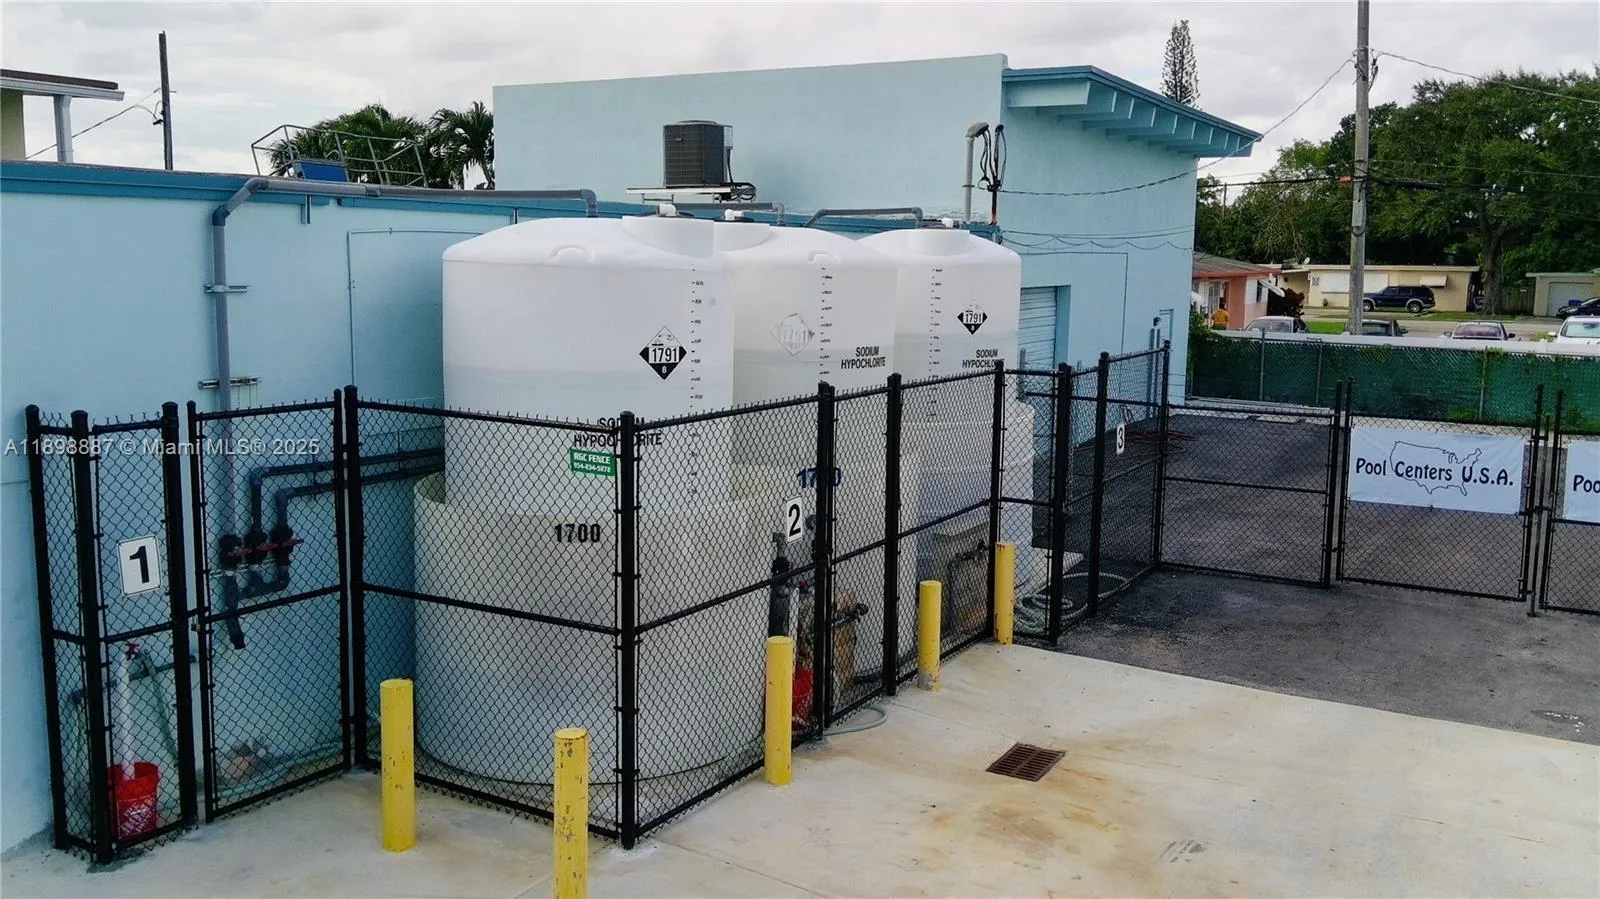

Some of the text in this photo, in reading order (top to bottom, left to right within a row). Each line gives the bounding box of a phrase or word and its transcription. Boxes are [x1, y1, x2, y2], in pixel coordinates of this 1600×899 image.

[965, 313, 982, 323] 1791
[652, 347, 677, 362] 1791
[856, 346, 879, 357] SODIUM
[976, 349, 998, 358] SODIUM
[841, 356, 886, 369] HYPOCHLORITE
[962, 359, 1004, 368] HYPOCHLO
[661, 365, 667, 374] 8
[599, 417, 645, 428] SOM
[574, 433, 662, 447] HYPOCHRITE
[1118, 427, 1123, 449] 3
[588, 454, 611, 464] FENCE
[796, 467, 842, 488] 170
[1356, 457, 1514, 486] Pool Centers U.S.A.
[788, 503, 801, 537] 2
[555, 523, 601, 543] 1700
[129, 545, 150, 584] 1
